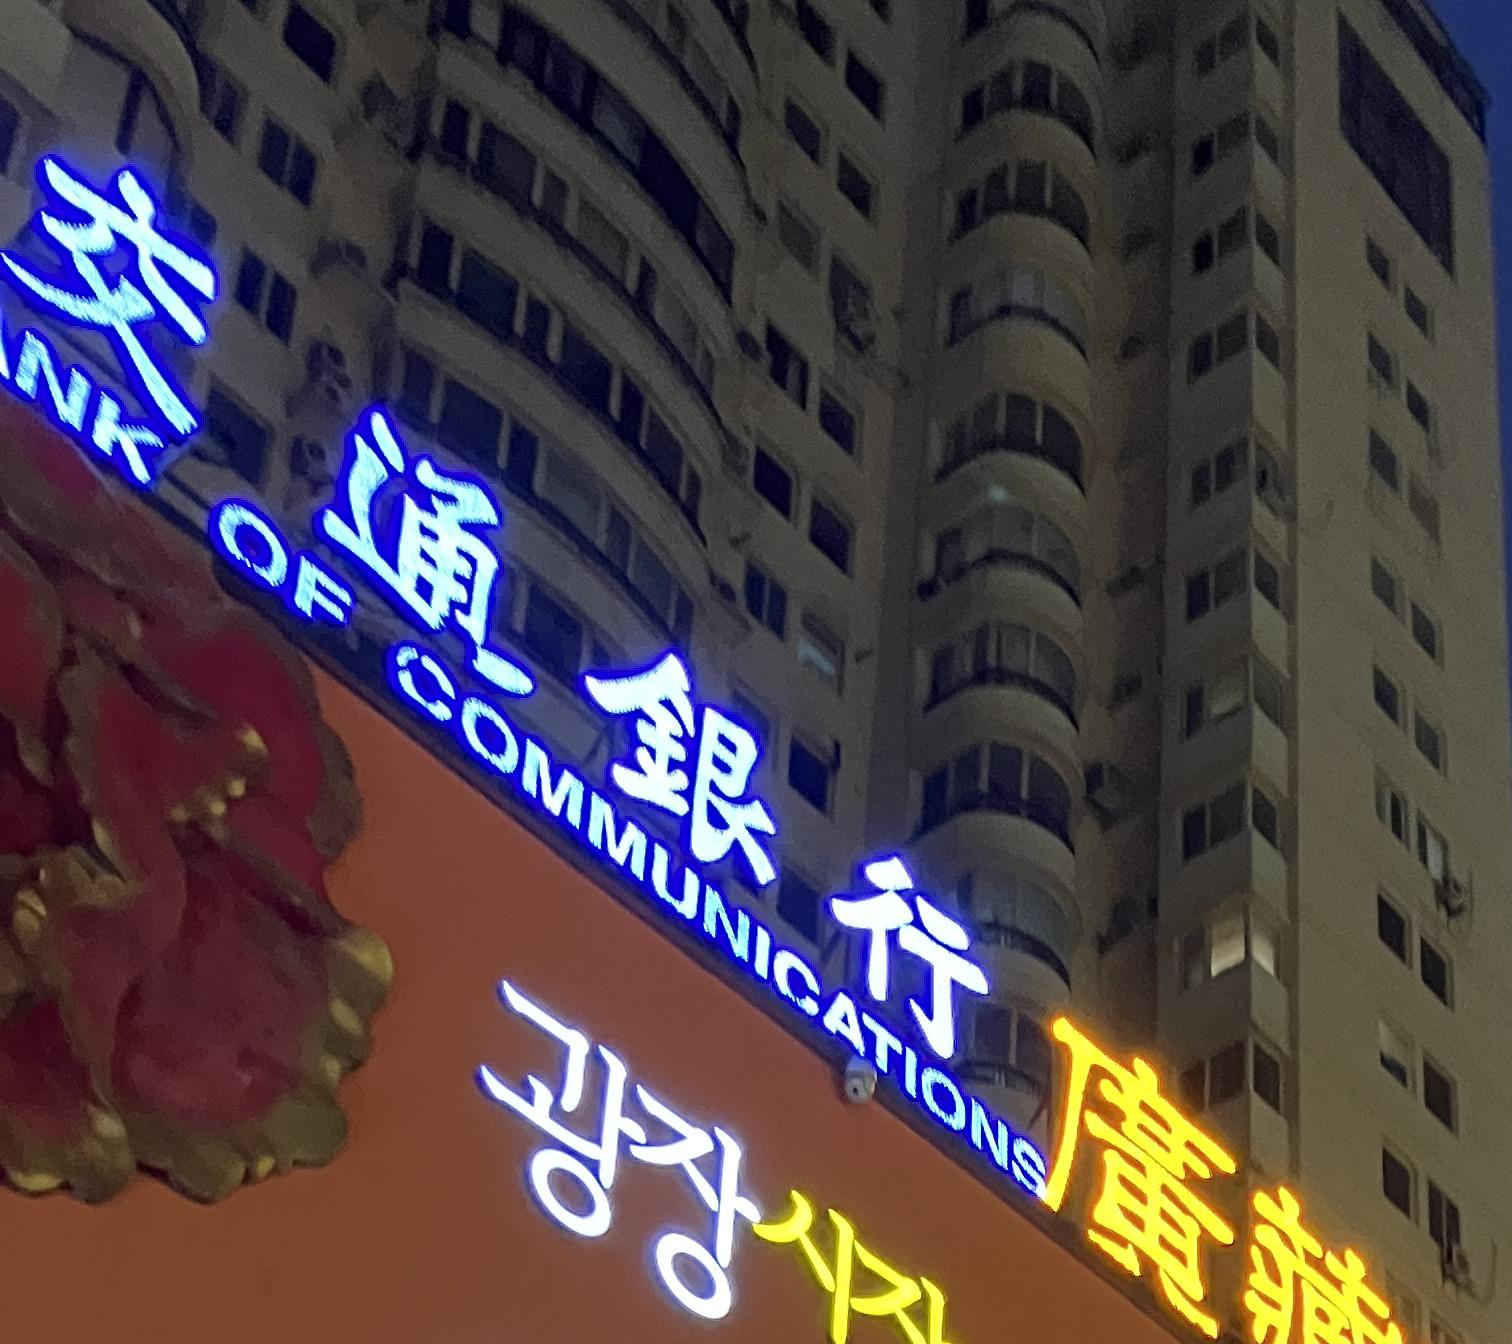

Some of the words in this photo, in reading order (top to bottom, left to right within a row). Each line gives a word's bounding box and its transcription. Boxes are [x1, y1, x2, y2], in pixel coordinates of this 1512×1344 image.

[0, 158, 990, 1060] 交通銀行
[0, 318, 166, 485] NK
[211, 502, 353, 624] OF
[396, 645, 1046, 1199] COMMUNICATIONS
